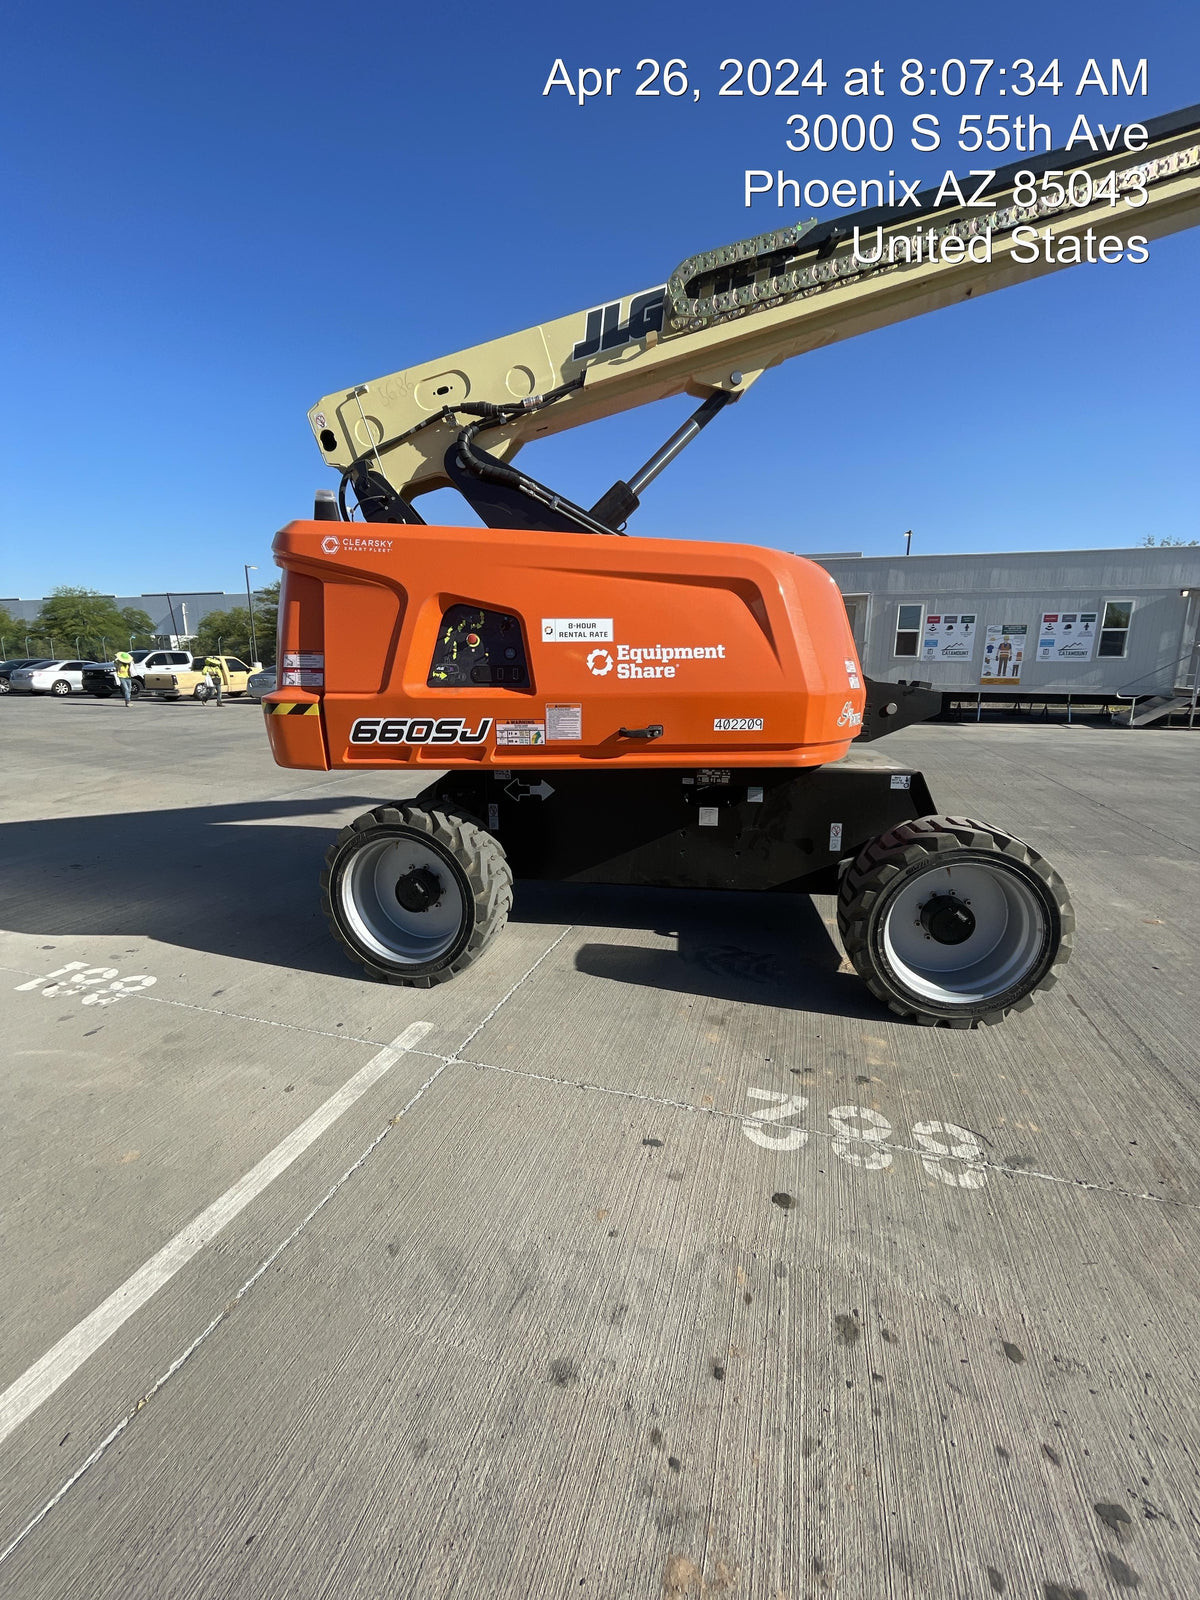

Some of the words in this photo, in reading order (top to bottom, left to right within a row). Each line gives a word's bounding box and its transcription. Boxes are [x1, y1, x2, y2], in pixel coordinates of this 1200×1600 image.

[572, 283, 667, 362] JLG
[342, 538, 393, 548] CLEARSKY
[568, 622, 597, 630] 8-HOUR
[558, 631, 588, 639] RENTAL
[617, 644, 726, 664] Equipment
[617, 663, 676, 679] Share
[349, 717, 494, 744] 660SJ
[714, 718, 763, 730] 402209
[742, 1086, 987, 1190] 882
